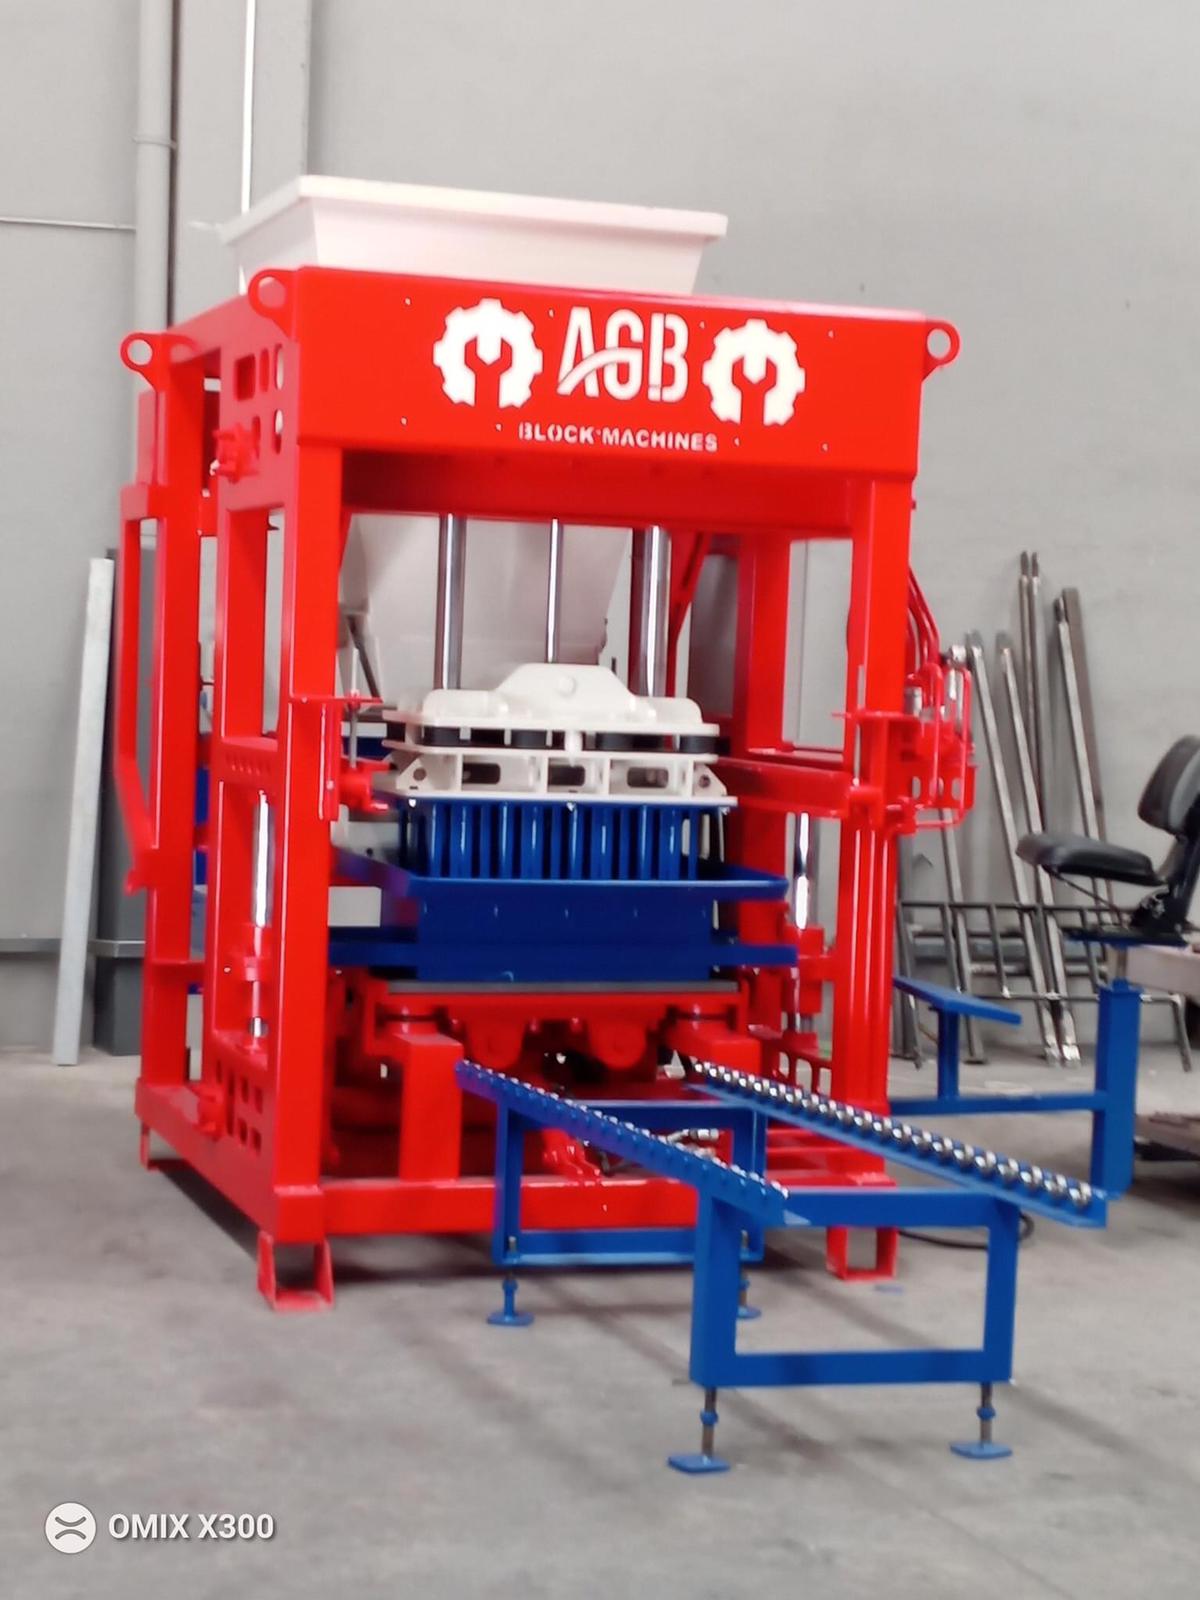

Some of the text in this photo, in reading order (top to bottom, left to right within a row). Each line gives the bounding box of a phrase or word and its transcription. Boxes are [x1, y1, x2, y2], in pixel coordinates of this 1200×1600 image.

[556, 306, 689, 403] AGB
[518, 421, 718, 453] BLOCK MACHINES
